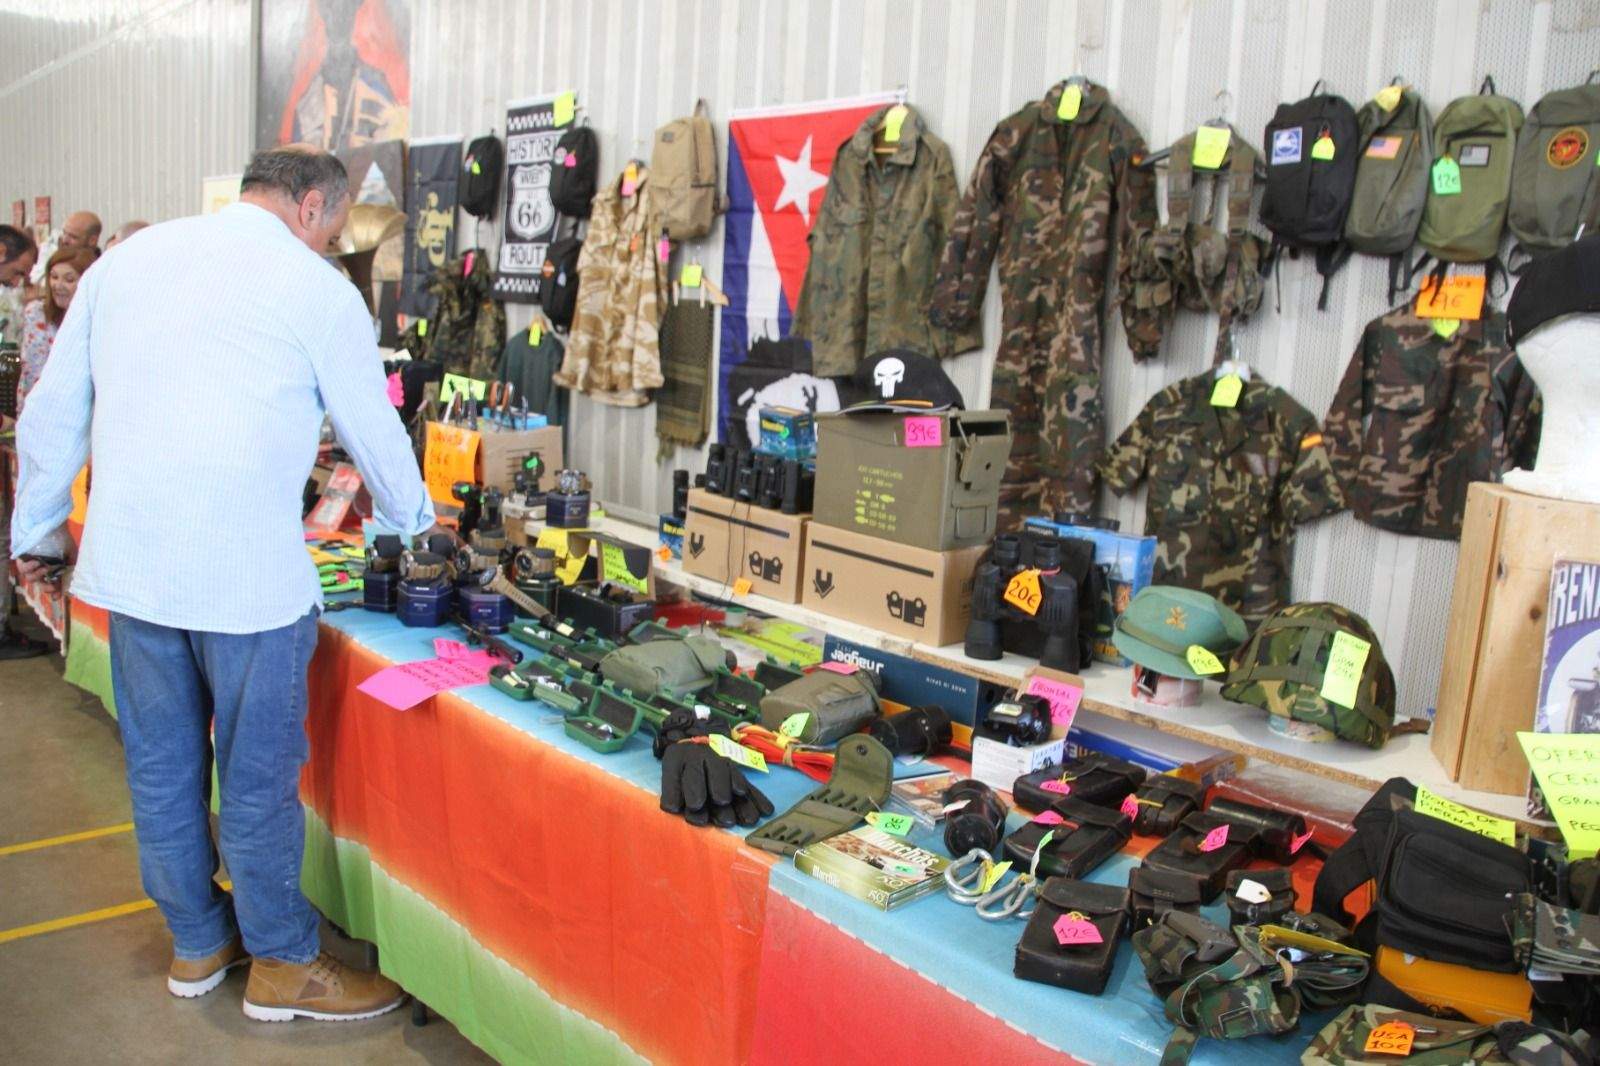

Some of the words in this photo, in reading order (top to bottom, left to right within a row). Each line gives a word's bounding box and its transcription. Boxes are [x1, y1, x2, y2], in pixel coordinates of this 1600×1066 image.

[518, 201, 542, 229] 66
[907, 422, 938, 442] 39€
[1008, 580, 1038, 609] 20€
[1058, 926, 1099, 939] 12€
[1372, 1030, 1409, 1041] USA
[1370, 1040, 1410, 1051] 10€
